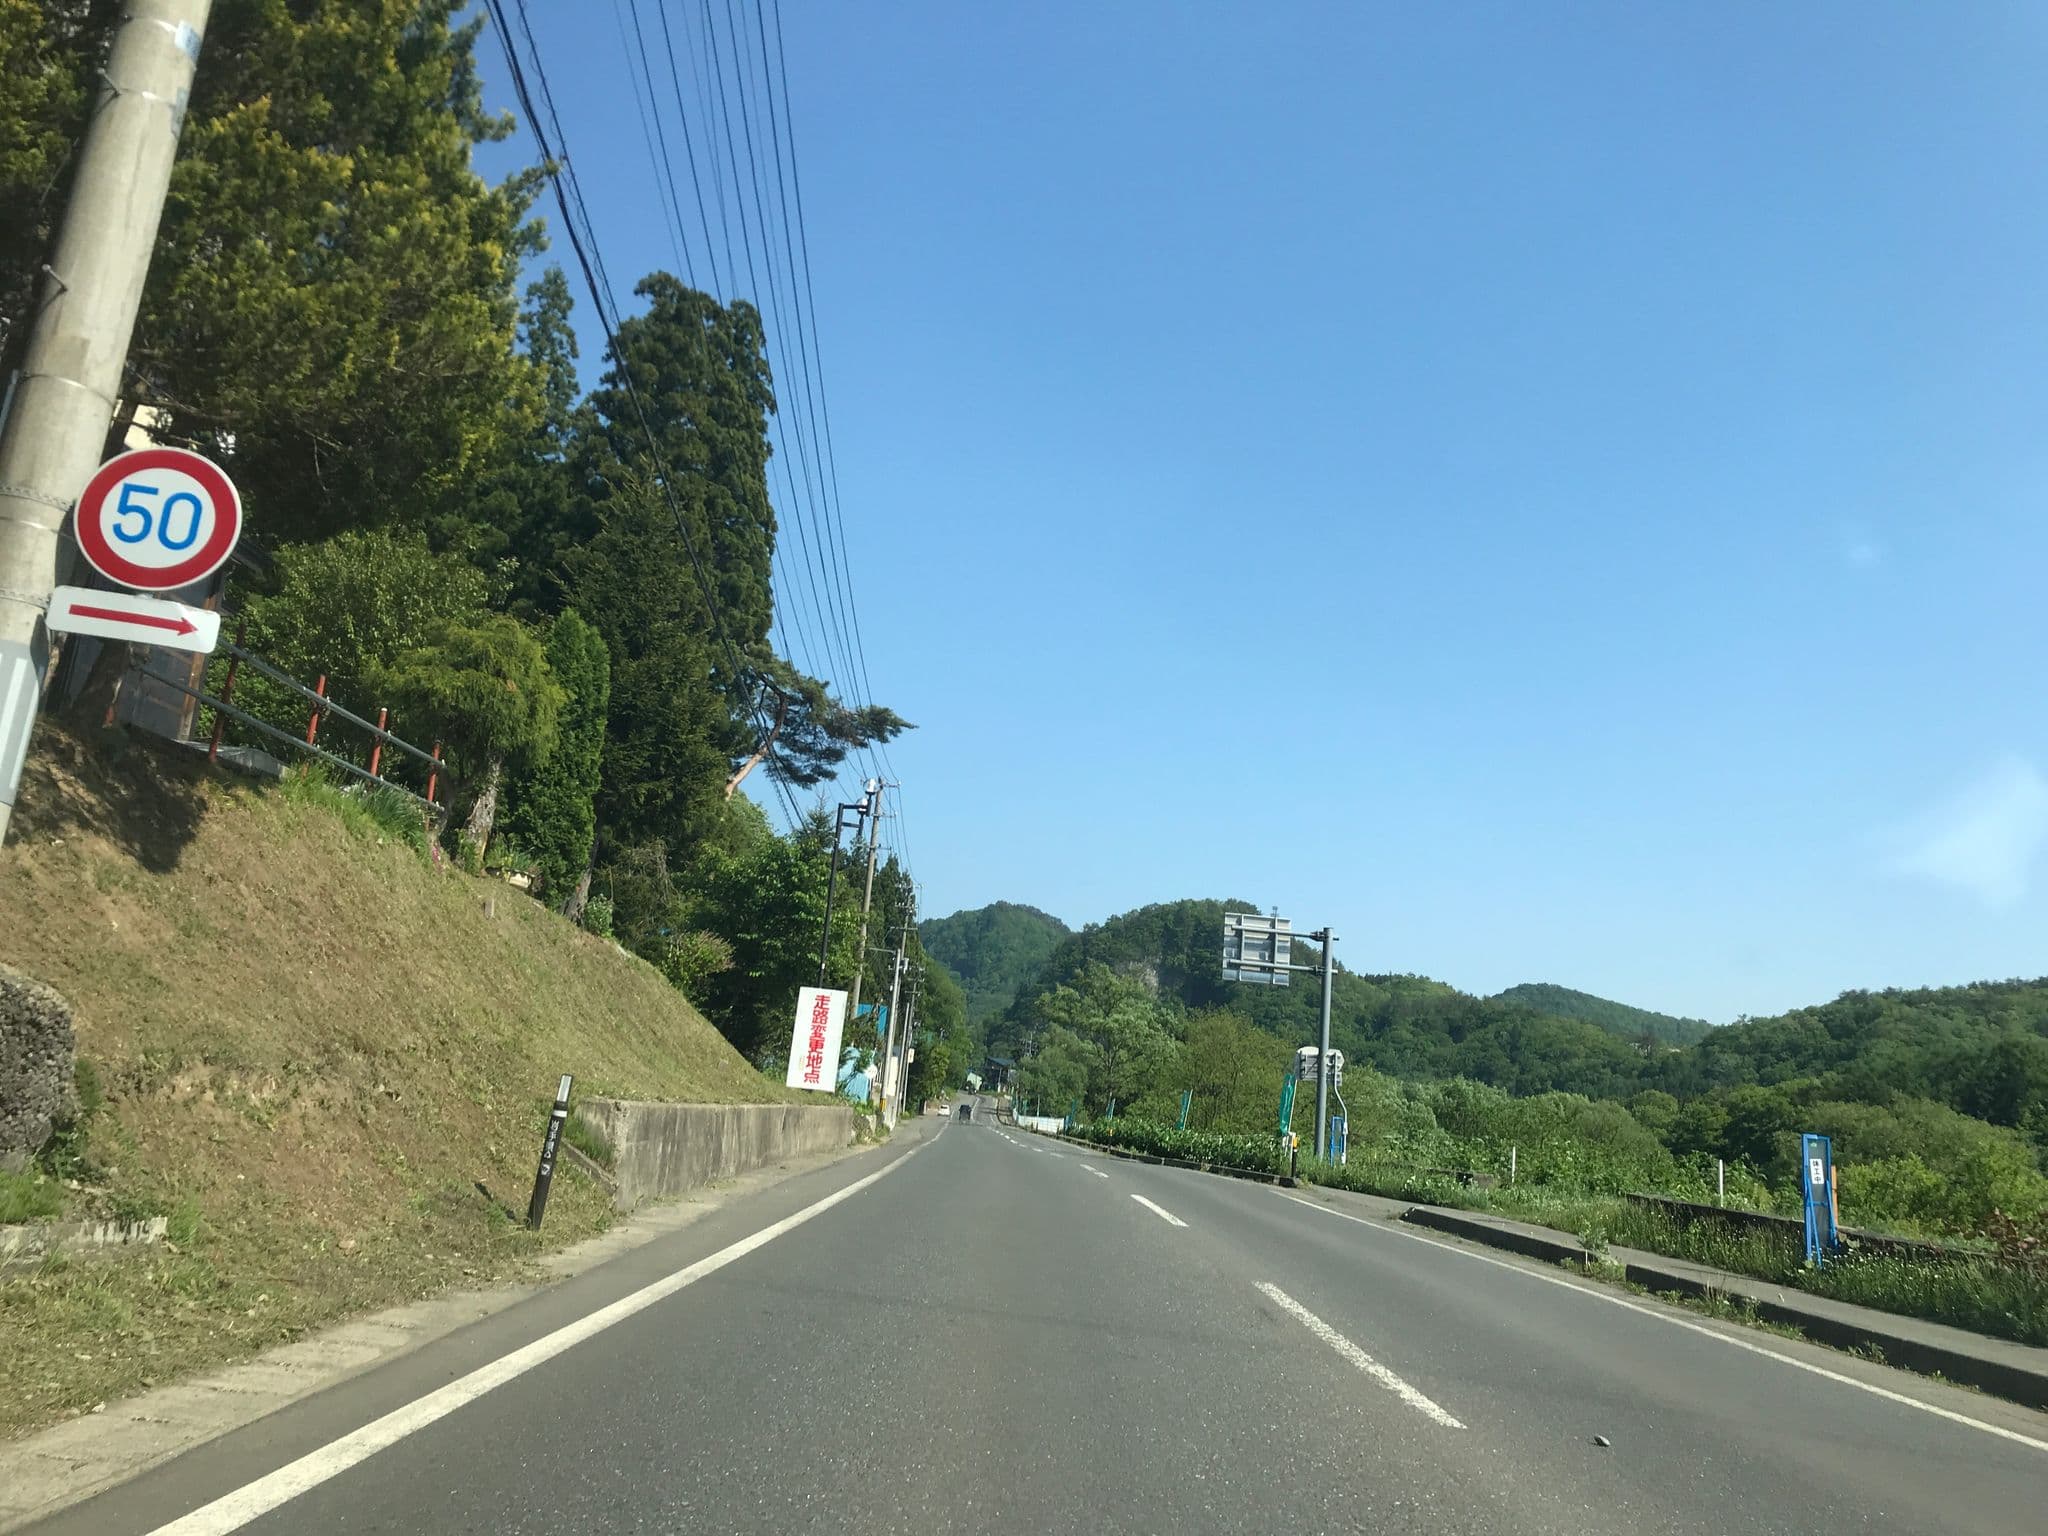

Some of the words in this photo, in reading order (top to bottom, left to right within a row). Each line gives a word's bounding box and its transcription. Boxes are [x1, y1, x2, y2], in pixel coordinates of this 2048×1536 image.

[113, 483, 202, 550] 50
[804, 994, 831, 1084] 走路変更地点
